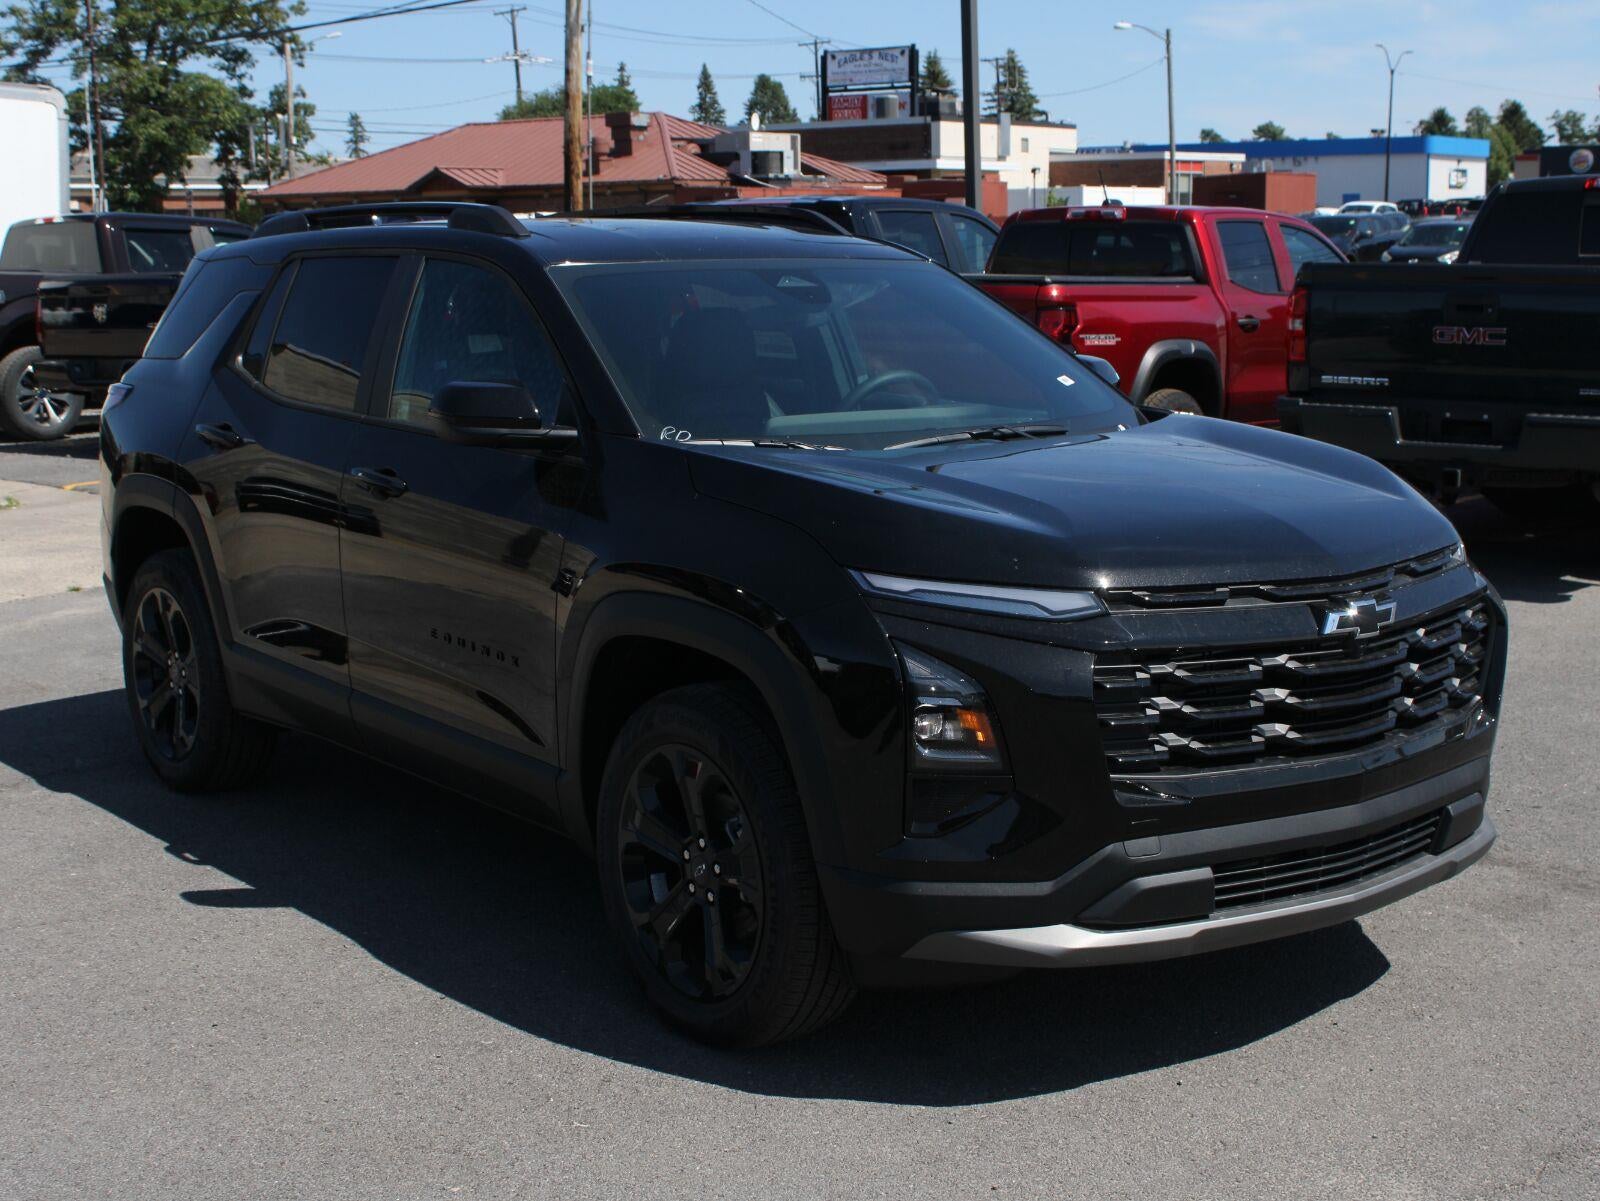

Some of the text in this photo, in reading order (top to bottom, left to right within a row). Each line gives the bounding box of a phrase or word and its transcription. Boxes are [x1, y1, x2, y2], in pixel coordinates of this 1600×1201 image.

[878, 51, 899, 64] NEST
[1432, 326, 1507, 345] GMC
[1321, 375, 1389, 386] SIERRA
[430, 627, 521, 667] EQUINOX
